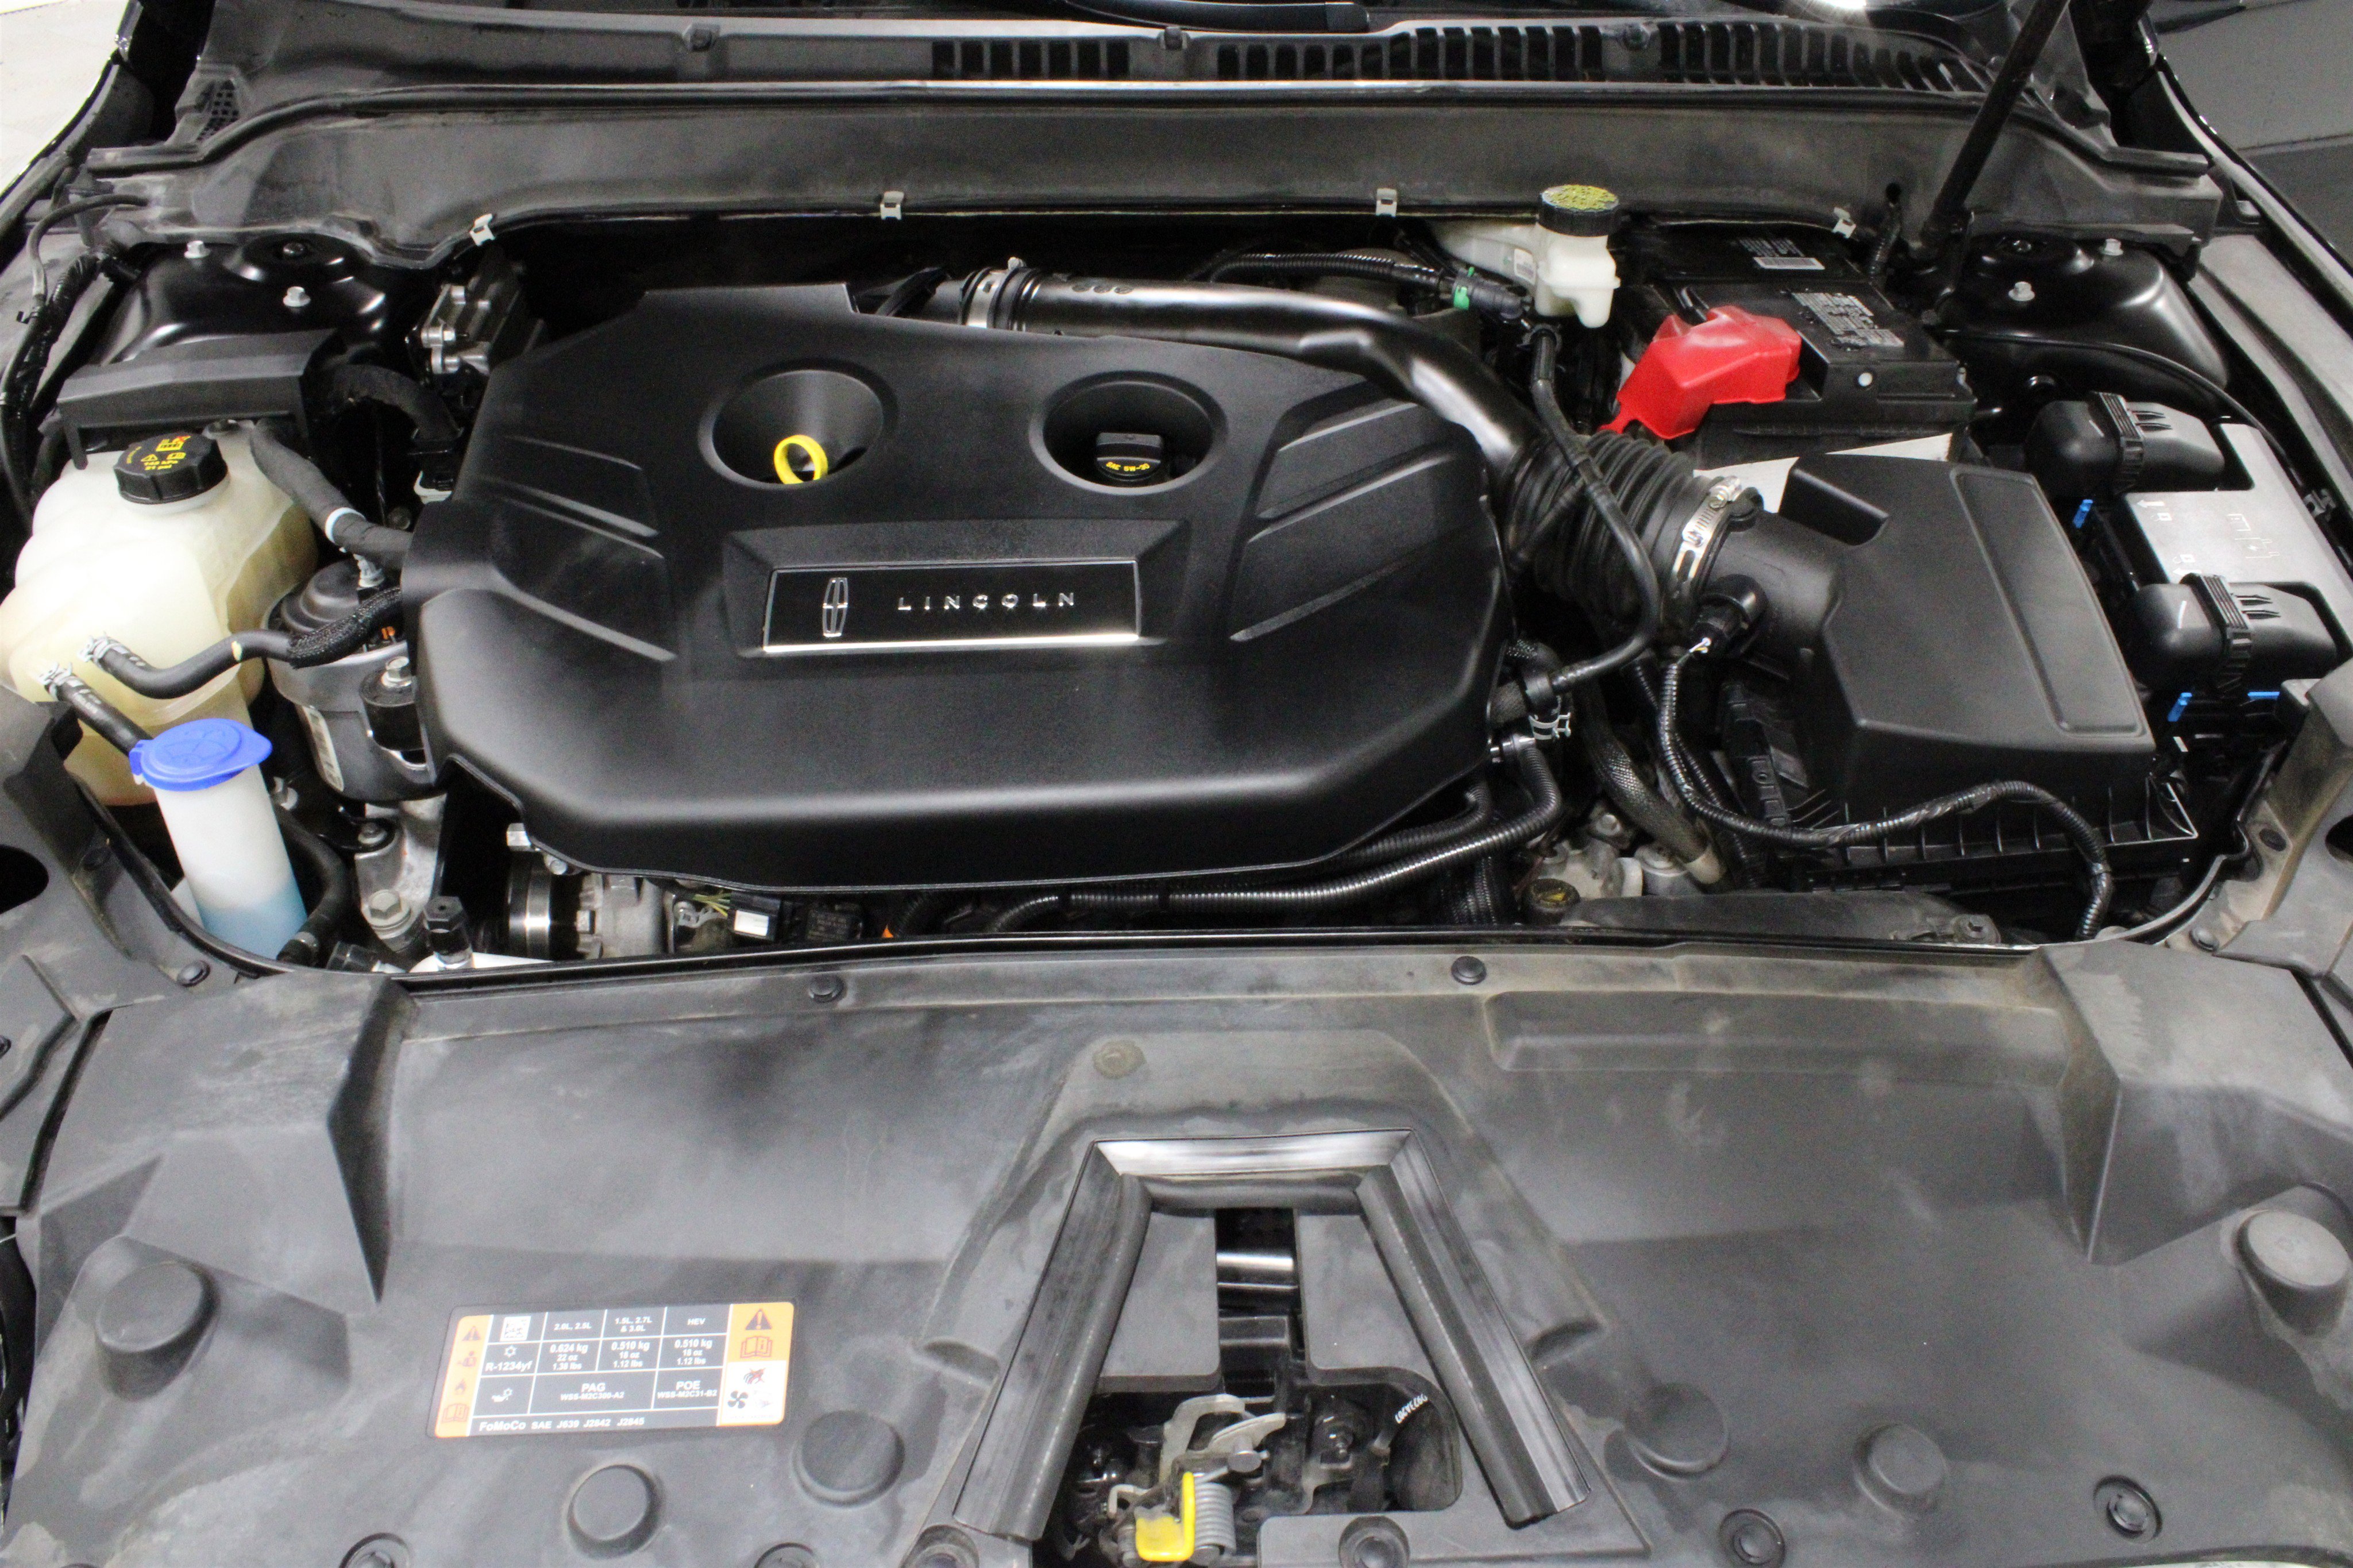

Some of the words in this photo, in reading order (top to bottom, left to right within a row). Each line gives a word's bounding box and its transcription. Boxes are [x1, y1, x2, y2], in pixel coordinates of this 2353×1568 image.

[1106, 461, 1121, 470] SAE
[897, 592, 1075, 612] LINCOLN
[635, 1316, 653, 1324] 2.7L
[687, 1318, 706, 1326] HEV
[550, 1343, 575, 1354] 0.624
[576, 1343, 589, 1354] kg
[611, 1341, 637, 1351] 0.510
[638, 1341, 650, 1352] kg
[674, 1339, 700, 1349] 0.510
[700, 1338, 713, 1350] kg
[557, 1354, 567, 1362] 22
[485, 1361, 533, 1372] R-1234yf
[613, 1360, 629, 1368] 1.12
[631, 1360, 643, 1368] lbs
[581, 1382, 606, 1392] PAG
[676, 1380, 701, 1391] POE
[479, 1420, 526, 1431] FoMoCo
[531, 1420, 553, 1430] SAE
[557, 1420, 580, 1429] J639
